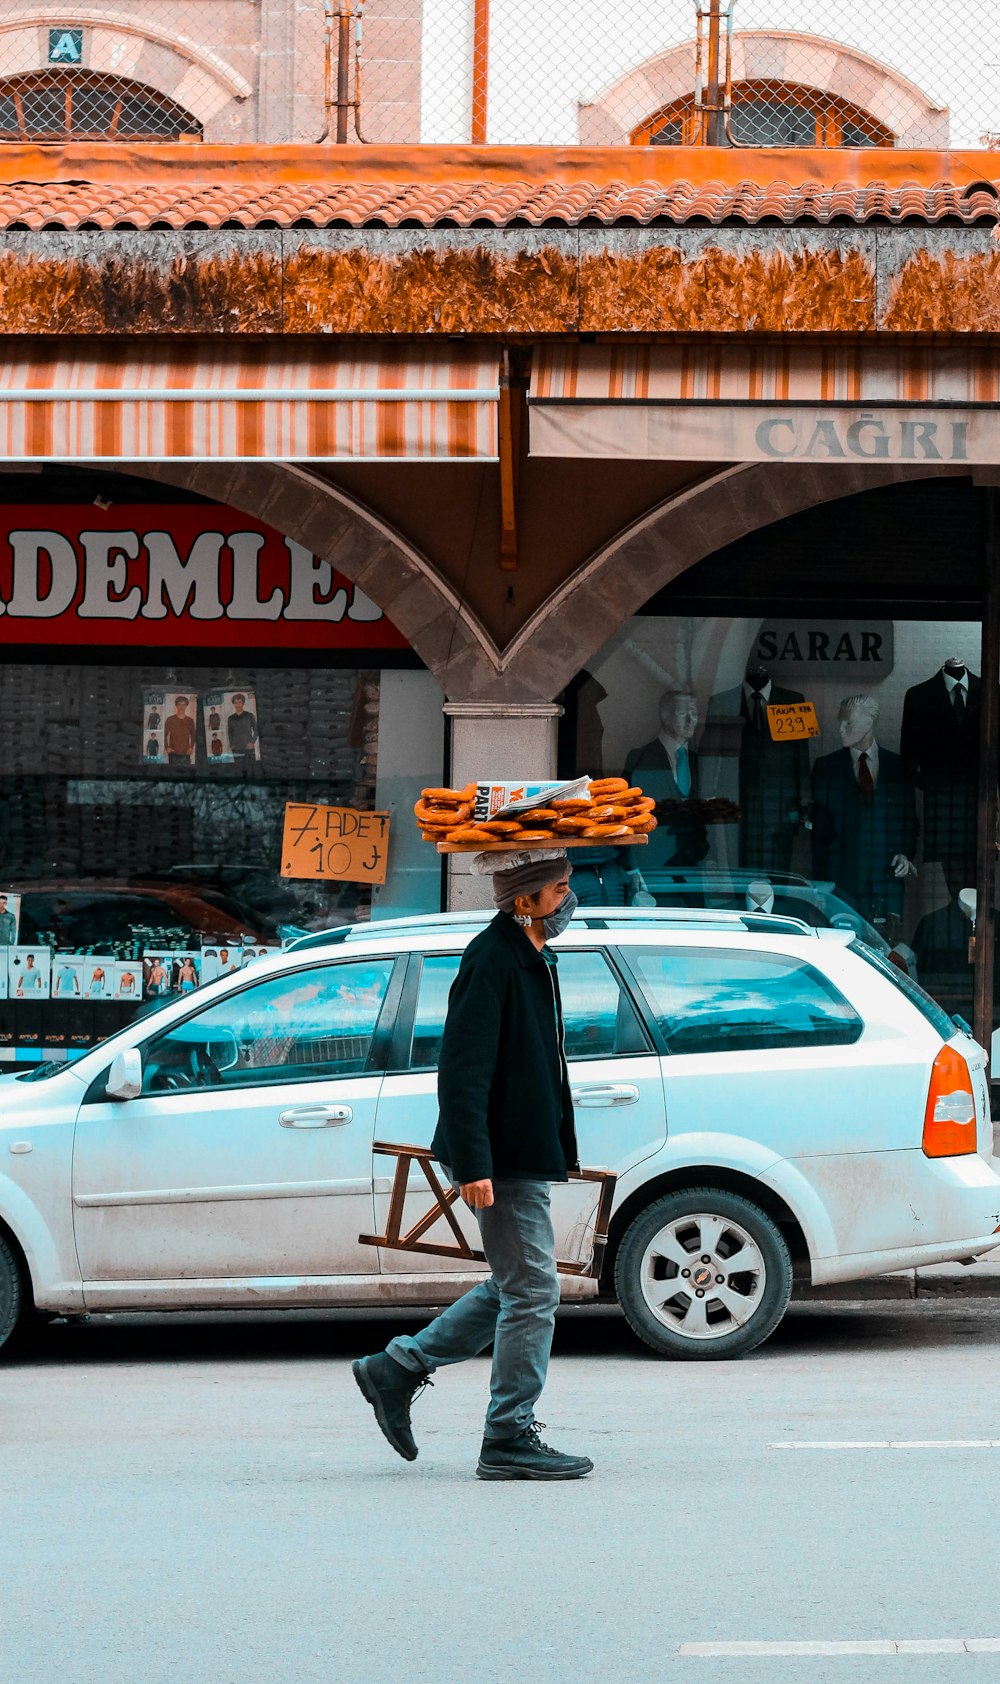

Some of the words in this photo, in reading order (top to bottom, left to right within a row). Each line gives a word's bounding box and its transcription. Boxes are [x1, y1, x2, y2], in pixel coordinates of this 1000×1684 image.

[51, 32, 80, 59] A
[0, 530, 383, 622] DEMLE
[757, 631, 883, 662] SARAR
[776, 716, 805, 733] 239
[288, 805, 318, 847] 7
[325, 811, 390, 838] ADET
